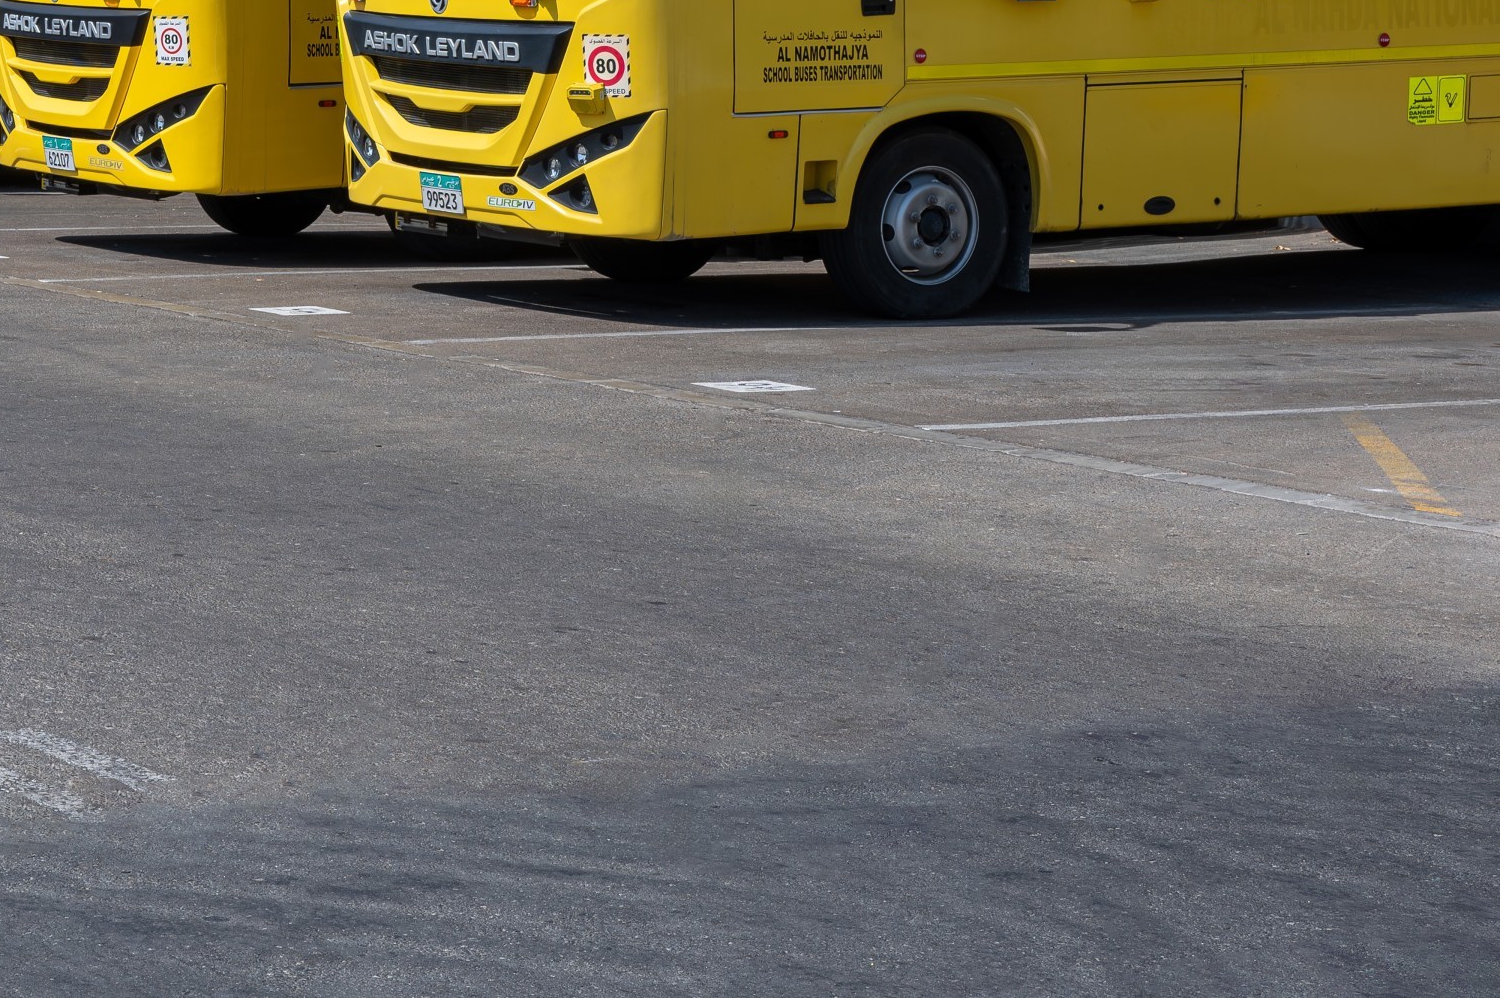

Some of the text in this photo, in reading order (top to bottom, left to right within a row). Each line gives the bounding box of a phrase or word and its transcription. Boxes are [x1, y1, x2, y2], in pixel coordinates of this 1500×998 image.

[3, 13, 112, 39] ASHOK LEYLAND
[320, 26, 332, 39] AL
[164, 34, 178, 44] 80
[763, 31, 795, 44] المدرسية
[797, 30, 829, 42] بالحافلات
[831, 30, 848, 42] للنقل
[307, 43, 334, 57] SCHOOL
[363, 29, 420, 55] ASHOK
[425, 36, 521, 62] LEYLAND
[777, 44, 869, 62] AL NAMOTHAJYA
[596, 58, 617, 74] 80
[763, 64, 883, 83] SCHOOL BUSES TRANSPORTATION
[48, 151, 70, 168] 62107
[436, 175, 443, 187] 2
[502, 184, 515, 194] ABS
[426, 190, 458, 210] 99523
[488, 197, 534, 209] EURO IV
